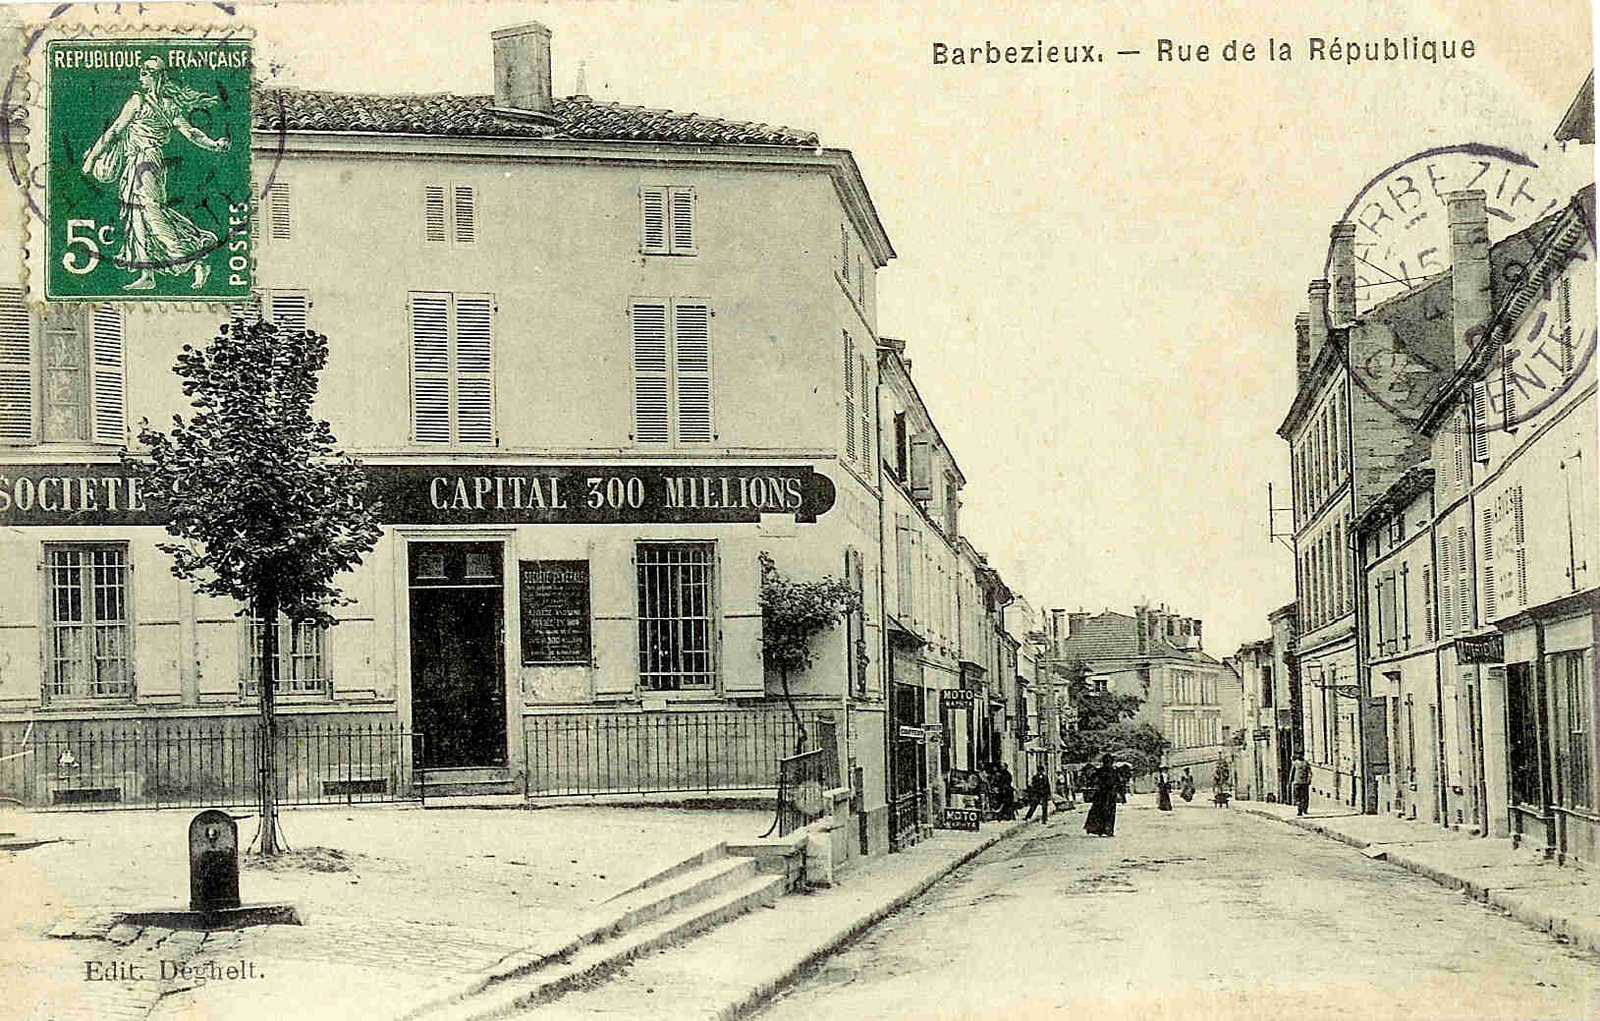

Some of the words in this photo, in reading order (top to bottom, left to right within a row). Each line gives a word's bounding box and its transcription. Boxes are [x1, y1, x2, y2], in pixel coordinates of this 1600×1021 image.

[228, 202, 248, 286] POSTES
[430, 476, 567, 510] CAPITAL
[587, 477, 645, 509] 300
[664, 476, 803, 510] MILLIONS
[943, 689, 973, 700] MOTO
